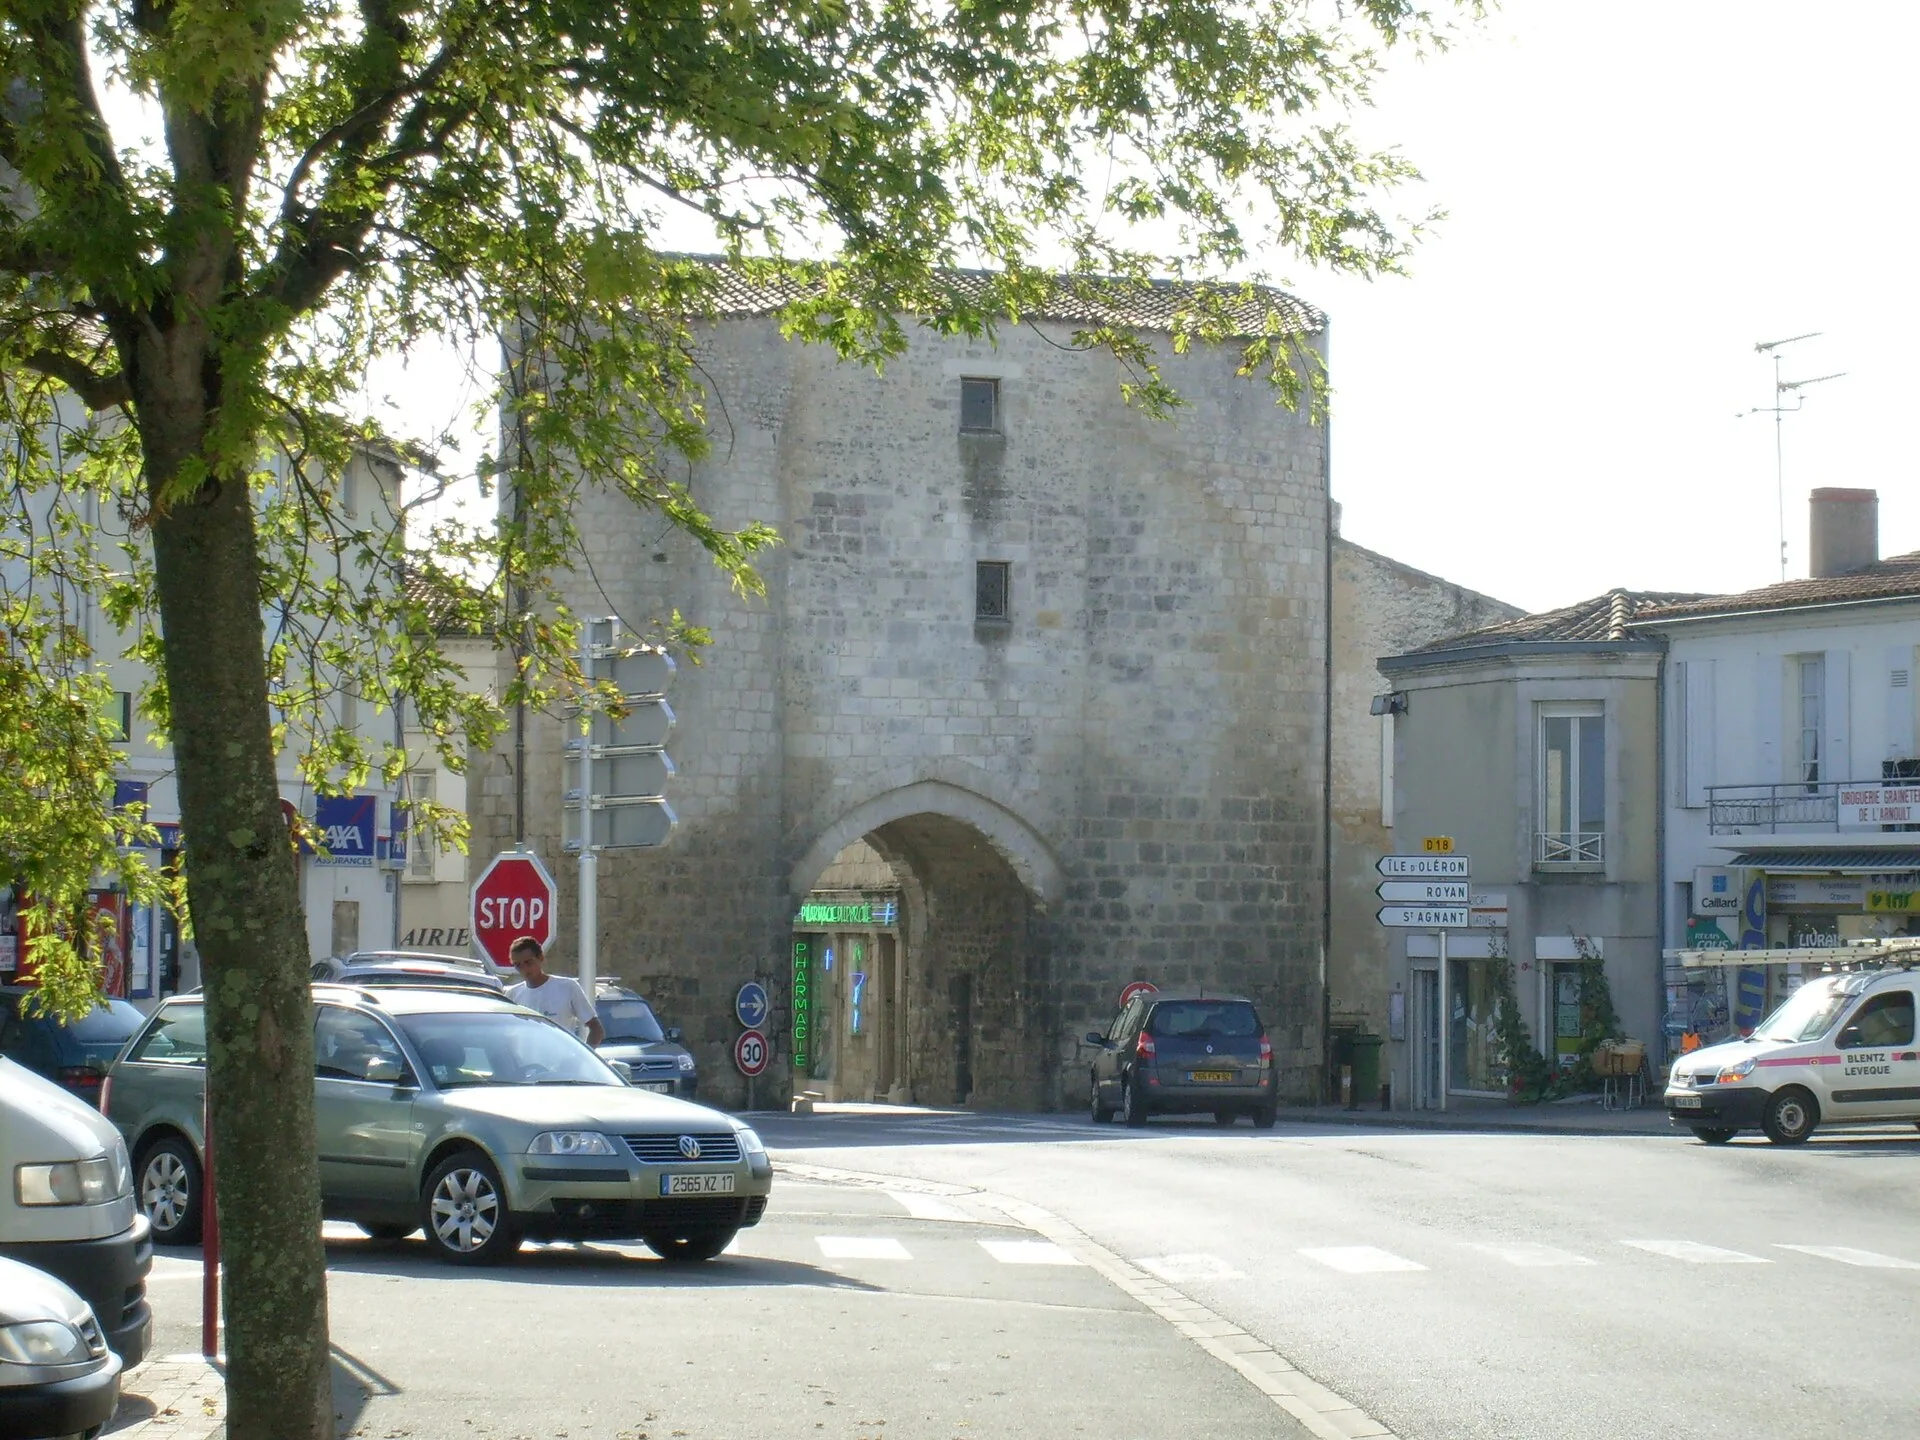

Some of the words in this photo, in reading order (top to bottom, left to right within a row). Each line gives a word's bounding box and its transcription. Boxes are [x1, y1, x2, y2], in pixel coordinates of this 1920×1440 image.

[1841, 790, 1880, 805] DROGUERIE
[1858, 807, 1868, 822] DE
[317, 824, 364, 850] AXA
[316, 856, 373, 865] ASSURANCES
[1388, 859, 1406, 872] ÎLE
[1426, 887, 1465, 898] ROYAN
[1701, 897, 1738, 908] Caillard
[479, 897, 544, 930] STOP
[1417, 912, 1465, 922] AGNANT
[1696, 940, 1729, 949] COLIS
[794, 943, 808, 1066] PHARMACIE
[743, 1043, 762, 1063] 30
[1847, 1053, 1886, 1063] BLENTZ
[1845, 1066, 1890, 1076] LEVEQUE
[672, 1176, 701, 1192] 2565
[703, 1176, 717, 1191] XZ
[722, 1175, 733, 1191] 17
